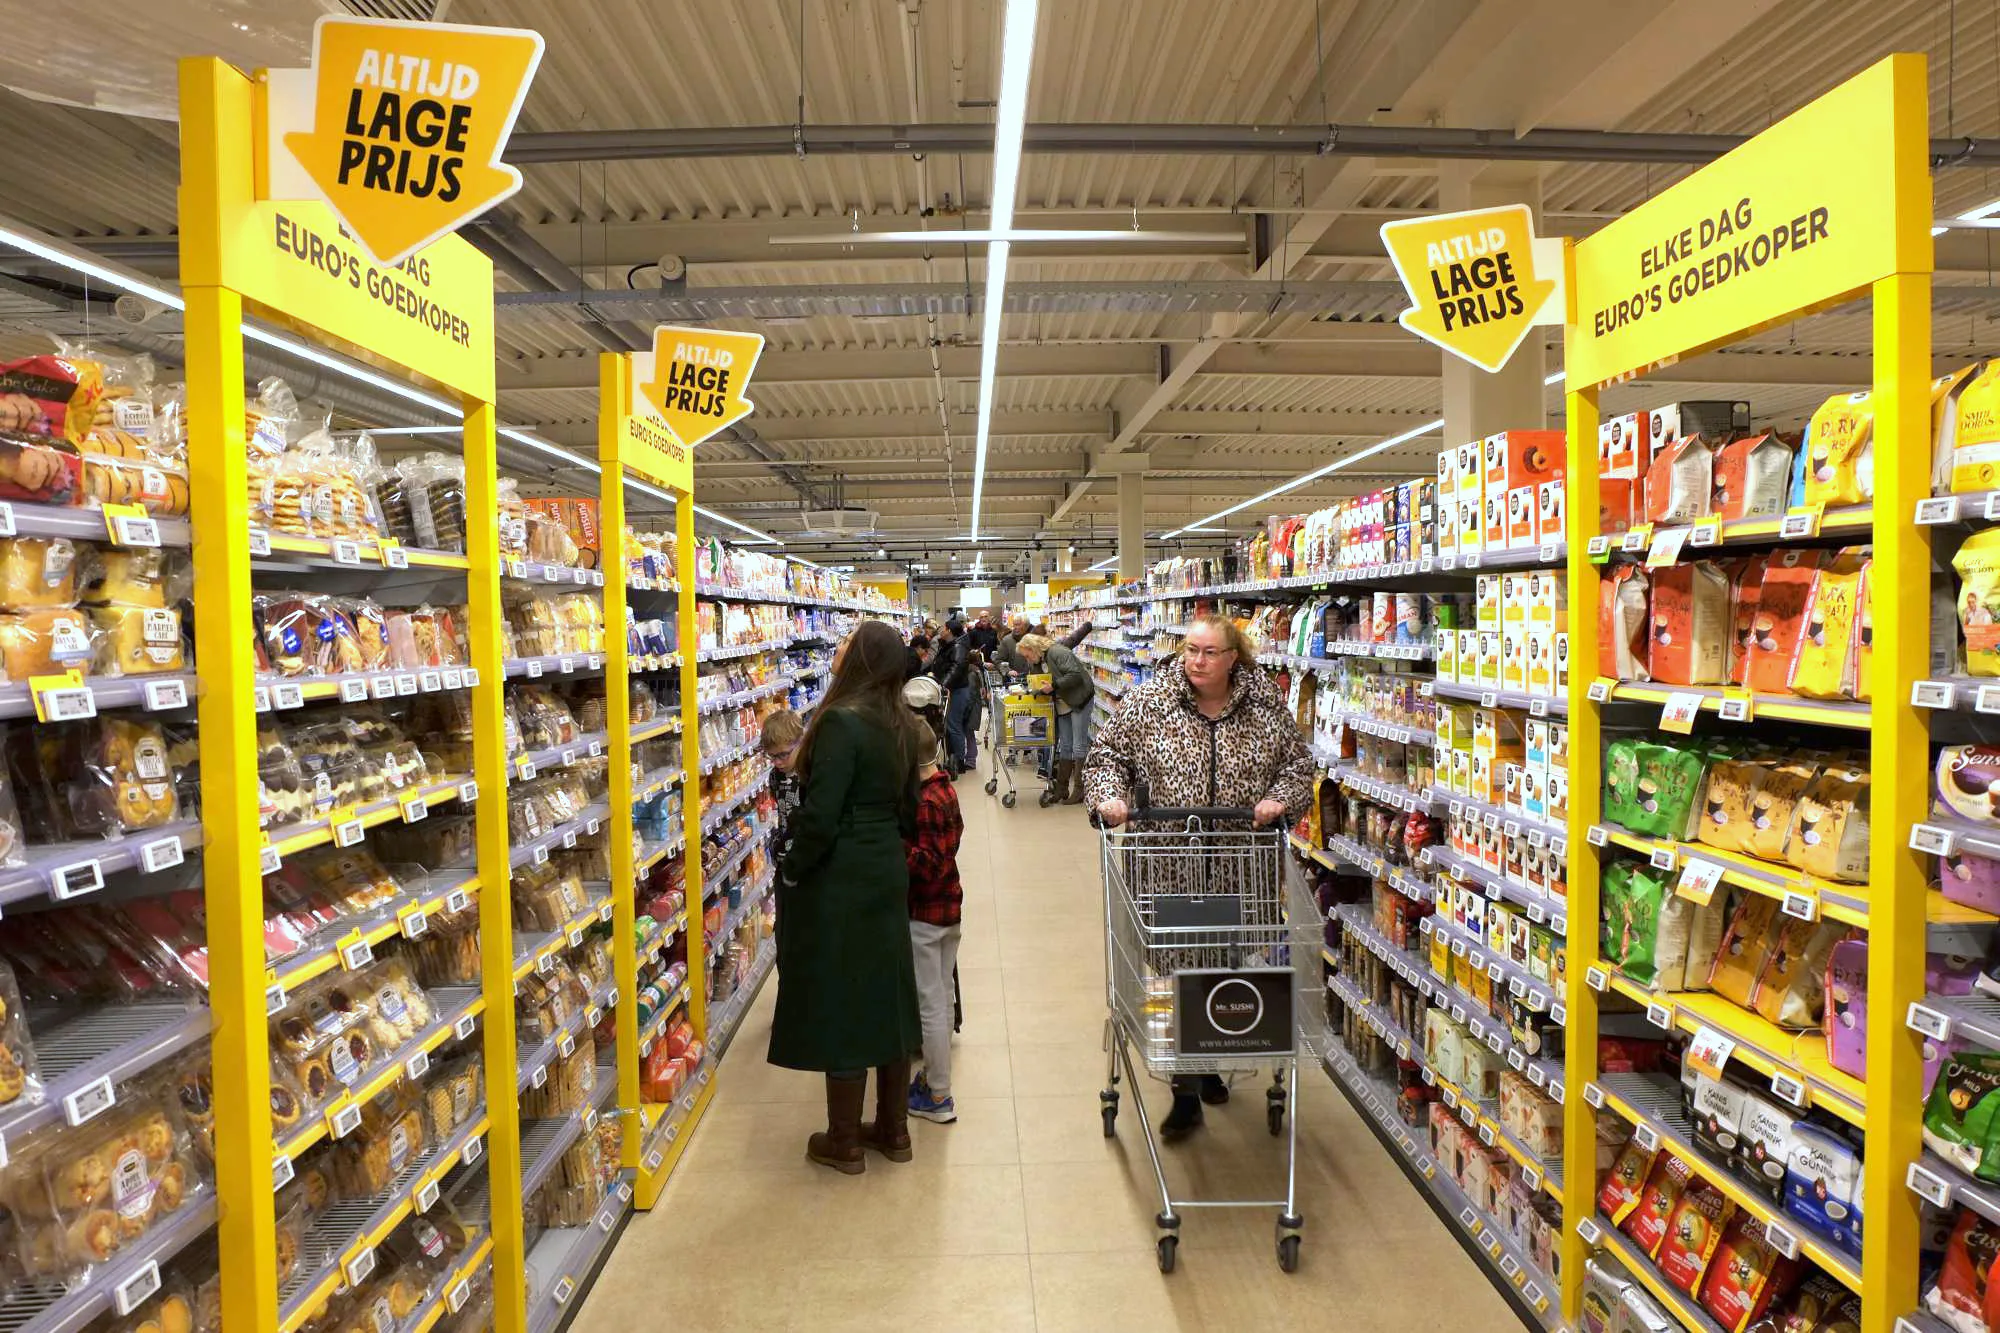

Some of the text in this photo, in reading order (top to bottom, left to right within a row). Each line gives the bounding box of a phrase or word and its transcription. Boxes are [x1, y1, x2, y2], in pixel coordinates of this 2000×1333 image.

[355, 49, 480, 101] ALTIJD
[345, 88, 472, 154] LAGE
[338, 140, 464, 203] PRIJS
[1427, 227, 1507, 267] ALTIJD
[1640, 197, 1753, 280] ELKE DAG
[275, 213, 471, 349] EURO'S GOEDKOPER
[1431, 252, 1514, 300] LAGE
[1594, 206, 1830, 338] EURO'S GOEDKOPER
[1440, 286, 1525, 332] PRIJS
[669, 361, 730, 394] LAGE
[673, 342, 734, 368] ALTIJD
[665, 386, 726, 418] PRIJS
[630, 418, 653, 447] EURO'S
[653, 432, 685, 465] GOEDKOPER
[1230, 1003, 1255, 1011] SUSHI
[1963, 1078, 1982, 1093] MILD
